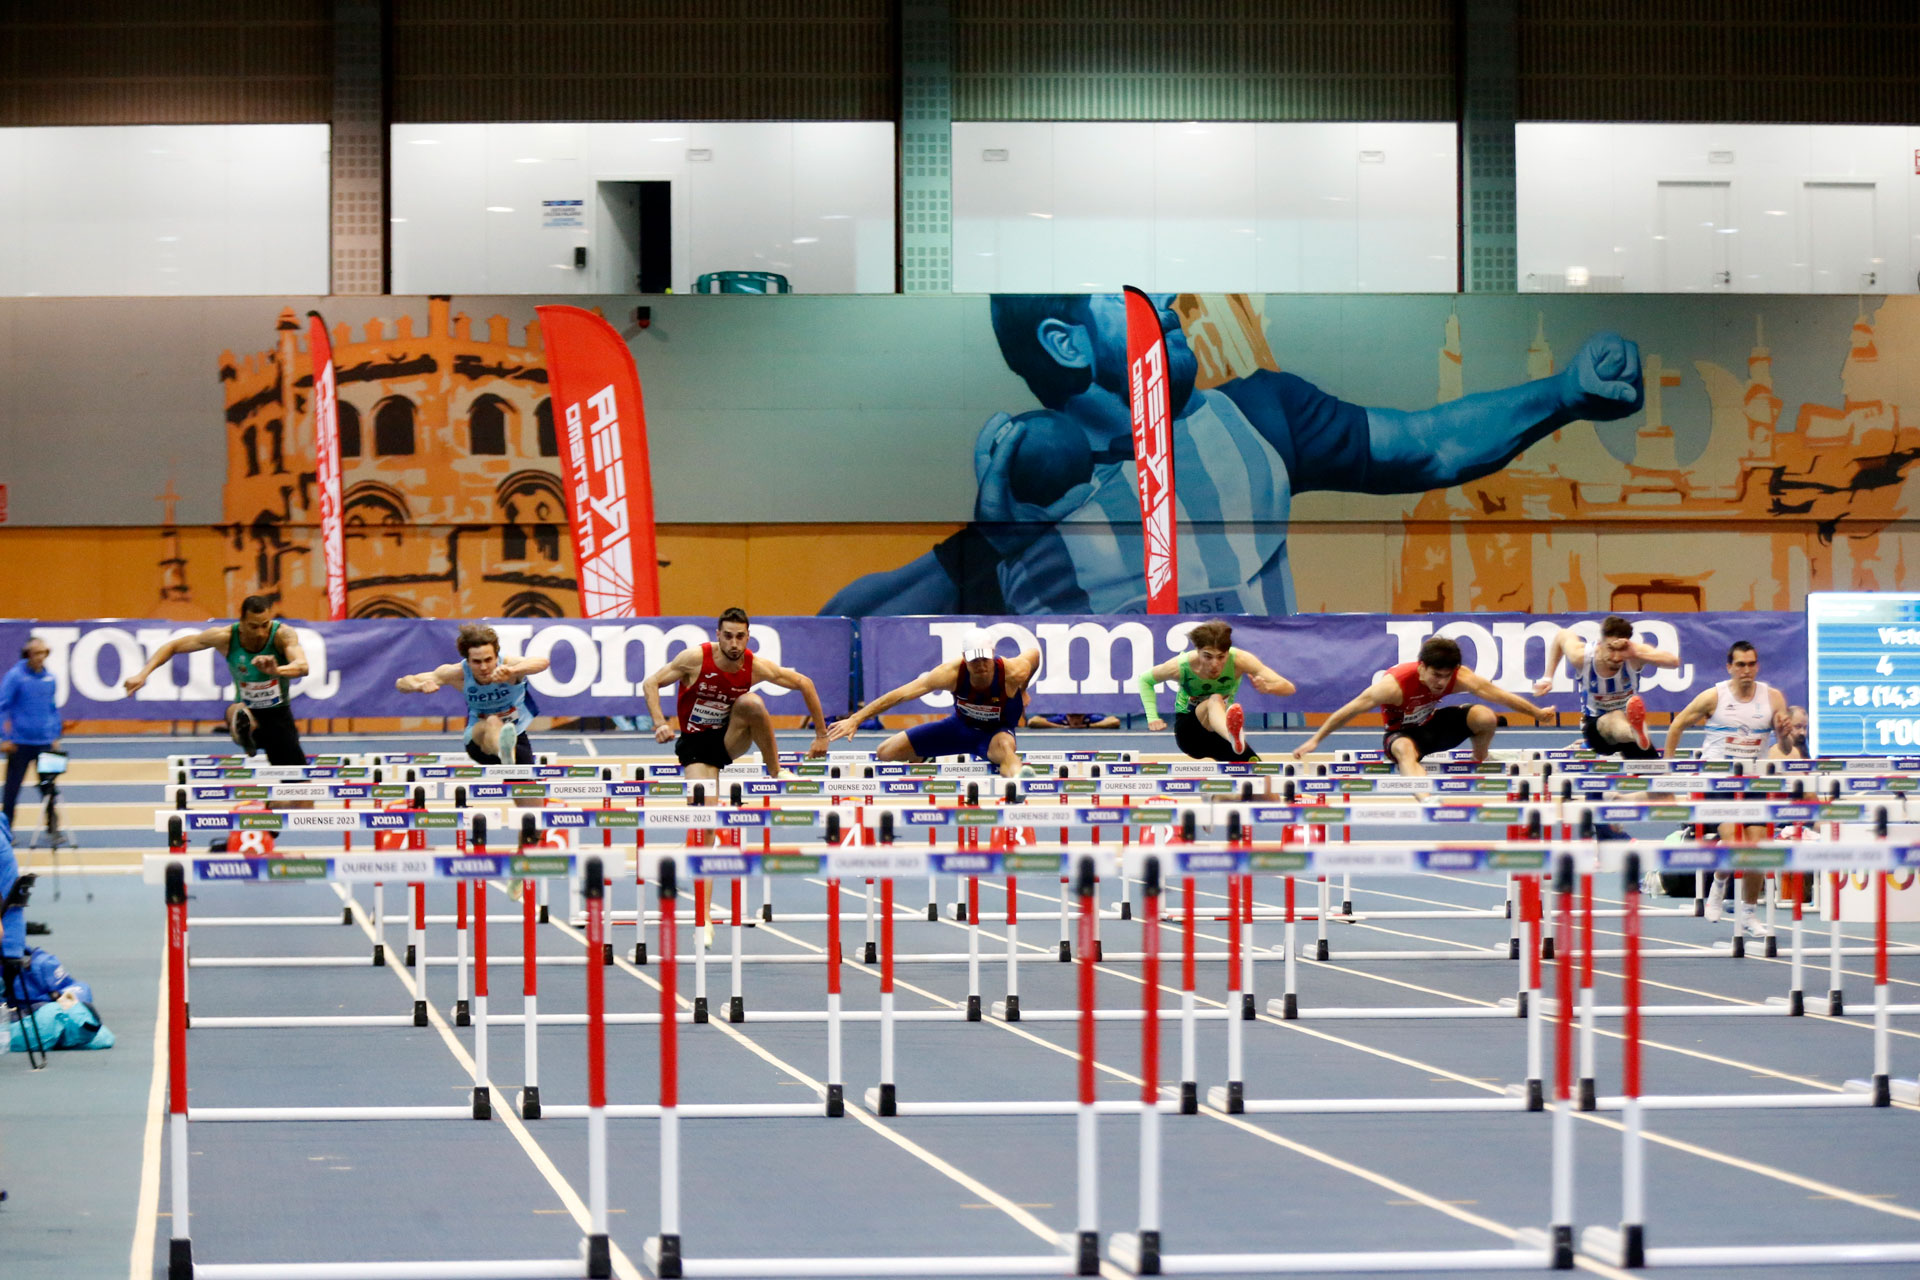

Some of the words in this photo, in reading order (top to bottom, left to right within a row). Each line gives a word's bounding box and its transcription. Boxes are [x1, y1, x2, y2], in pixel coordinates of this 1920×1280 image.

[1876, 655, 1894, 677] 4
[1853, 685, 1870, 707] 8
[554, 786, 584, 794] OURENSE
[587, 786, 603, 794] 2023
[827, 783, 860, 791] OURENSE
[861, 783, 877, 791] 2023
[1104, 782, 1136, 790] OURENSE
[1138, 782, 1154, 790] 2023
[1381, 781, 1413, 789] OURENSE
[1414, 781, 1430, 789] 2023
[276, 788, 308, 796] OURENSE
[310, 788, 326, 796] 2023
[293, 816, 334, 826] OURENSE
[336, 816, 356, 826] 2023
[649, 814, 690, 824] OURENSE
[692, 814, 713, 824] 2023
[1008, 812, 1049, 821] OURENSE
[1051, 812, 1071, 821] 2023
[840, 822, 867, 850] 4
[240, 829, 266, 856] 8
[342, 861, 397, 874] OURENSE
[400, 861, 431, 874] 2023
